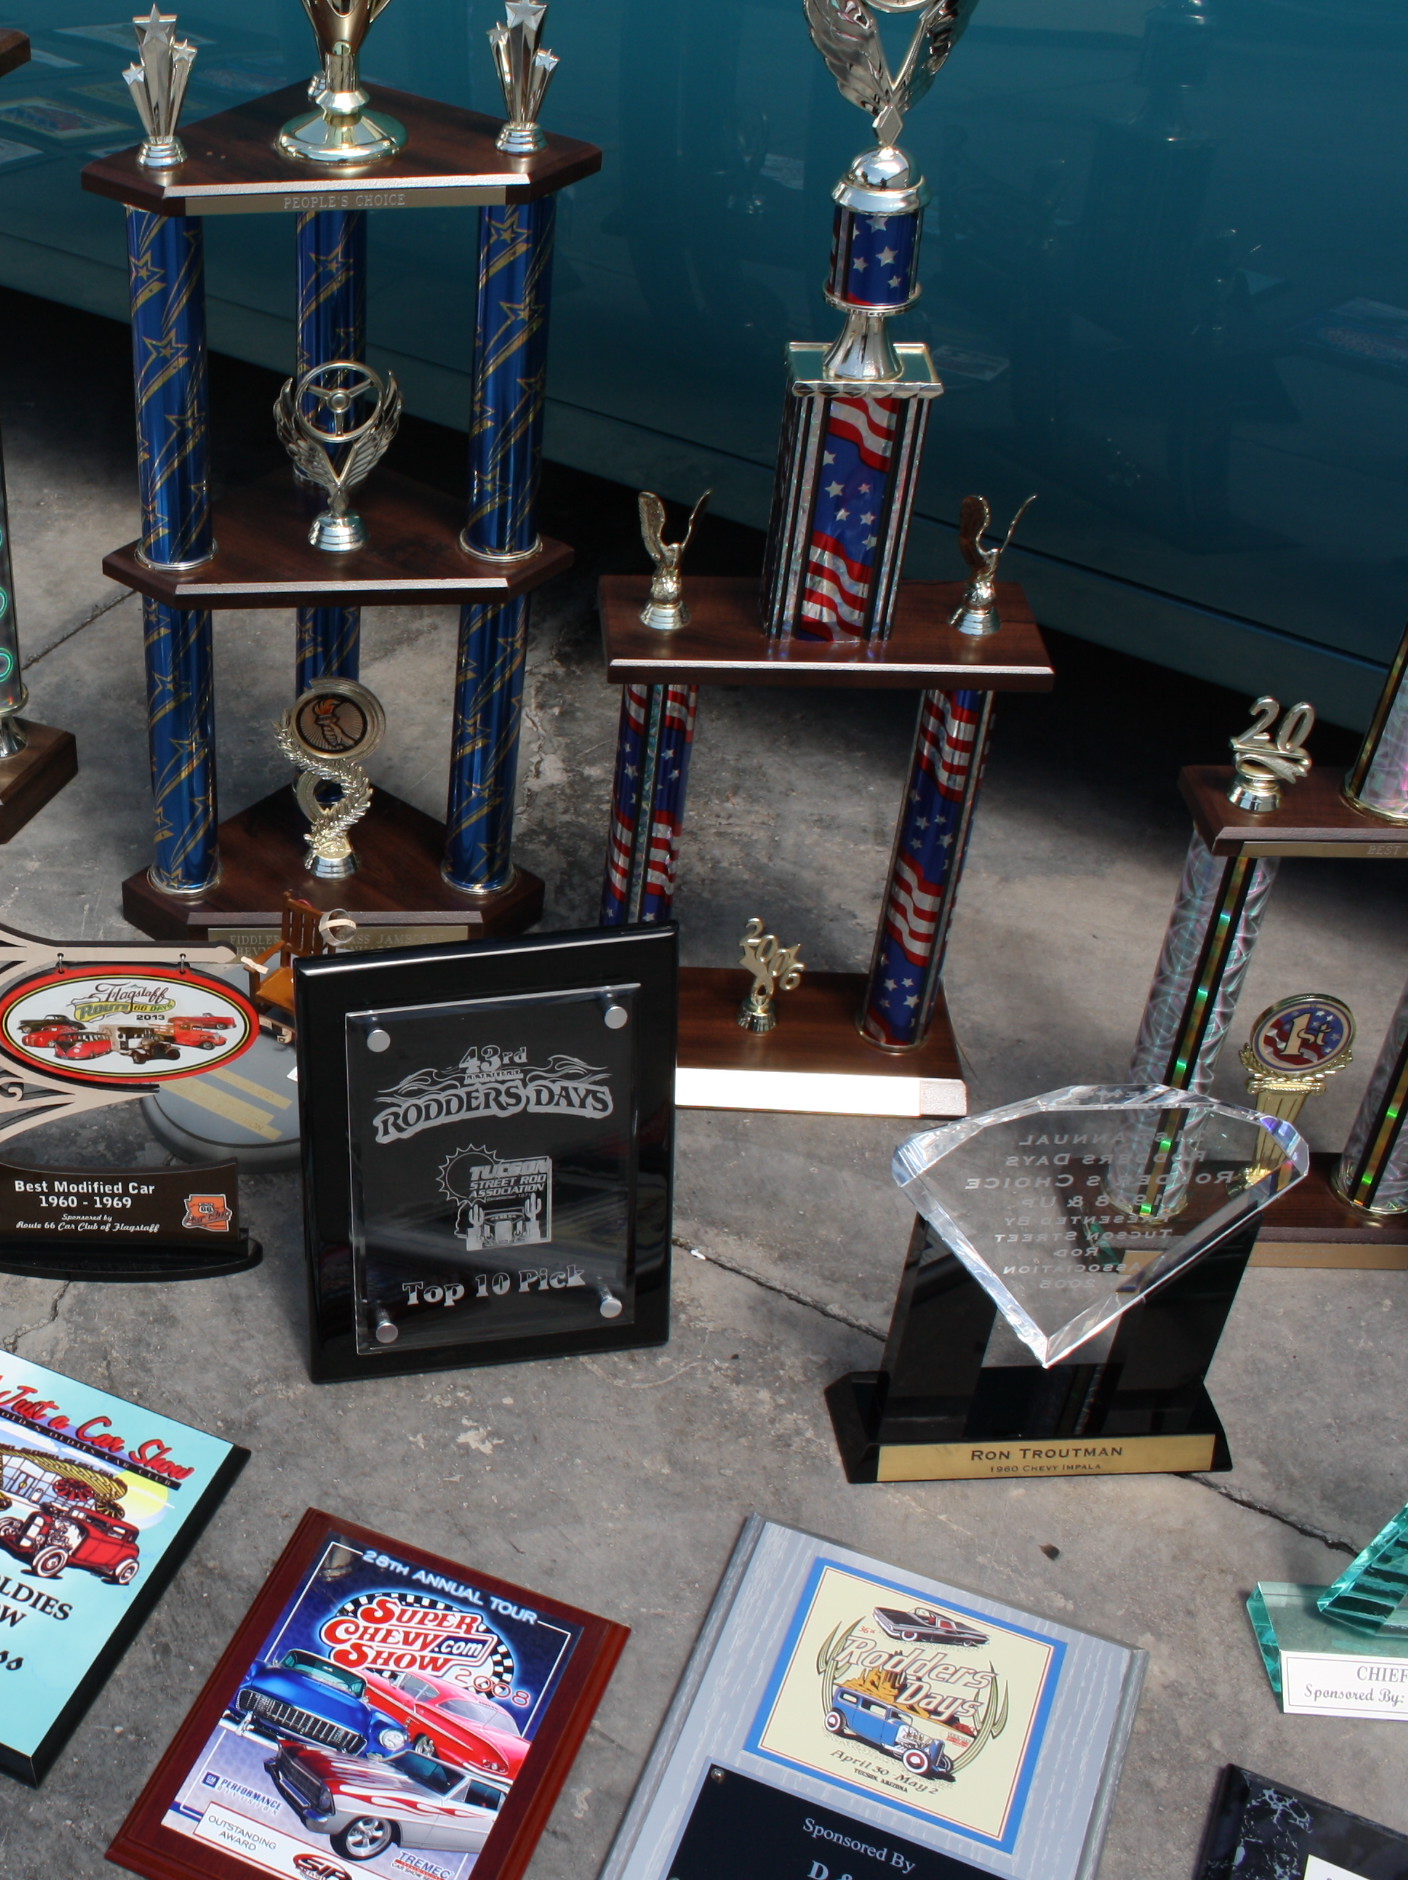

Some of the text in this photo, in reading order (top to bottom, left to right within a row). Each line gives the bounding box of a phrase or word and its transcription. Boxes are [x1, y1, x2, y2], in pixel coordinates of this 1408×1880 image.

[284, 193, 406, 209] PEOPLE'S CHOICE
[1232, 695, 1315, 753] 20
[1368, 846, 1401, 855] BEST
[738, 916, 808, 992] 2006
[149, 1002, 175, 1012] DAYS
[1279, 1010, 1332, 1057] 1st
[378, 1082, 523, 1140] RODDERS
[14, 1180, 155, 1195] Best Modified Car
[468, 1182, 546, 1200] ASSOCIATION
[469, 1172, 548, 1191] STREET ROD
[39, 1196, 132, 1208] 1960 1969
[61, 1213, 102, 1221] Sponsored
[16, 1221, 160, 1232] Route 66 Car Club Flagstaff
[401, 1264, 586, 1307] Top 10 Pick
[48, 1417, 71, 1430] a
[76, 1415, 125, 1453] Car
[129, 1438, 195, 1481] Show
[969, 1445, 1123, 1462] RON TROUTMAN
[989, 1461, 1103, 1474] 1960 CHEVY IMPALA
[412, 1569, 540, 1626] ANNUAL TOUR
[356, 1598, 484, 1635] SUPER
[330, 1644, 452, 1674] SHOW
[835, 1636, 999, 1690] Rodders
[896, 1677, 984, 1722] Days
[1303, 1682, 1405, 1705] Sponsored By:
[220, 1778, 282, 1811] PERFORMANCE
[207, 1815, 278, 1850] OUTSTANDING
[218, 1830, 257, 1852] AWARD
[801, 1817, 916, 1874] Sponsored By
